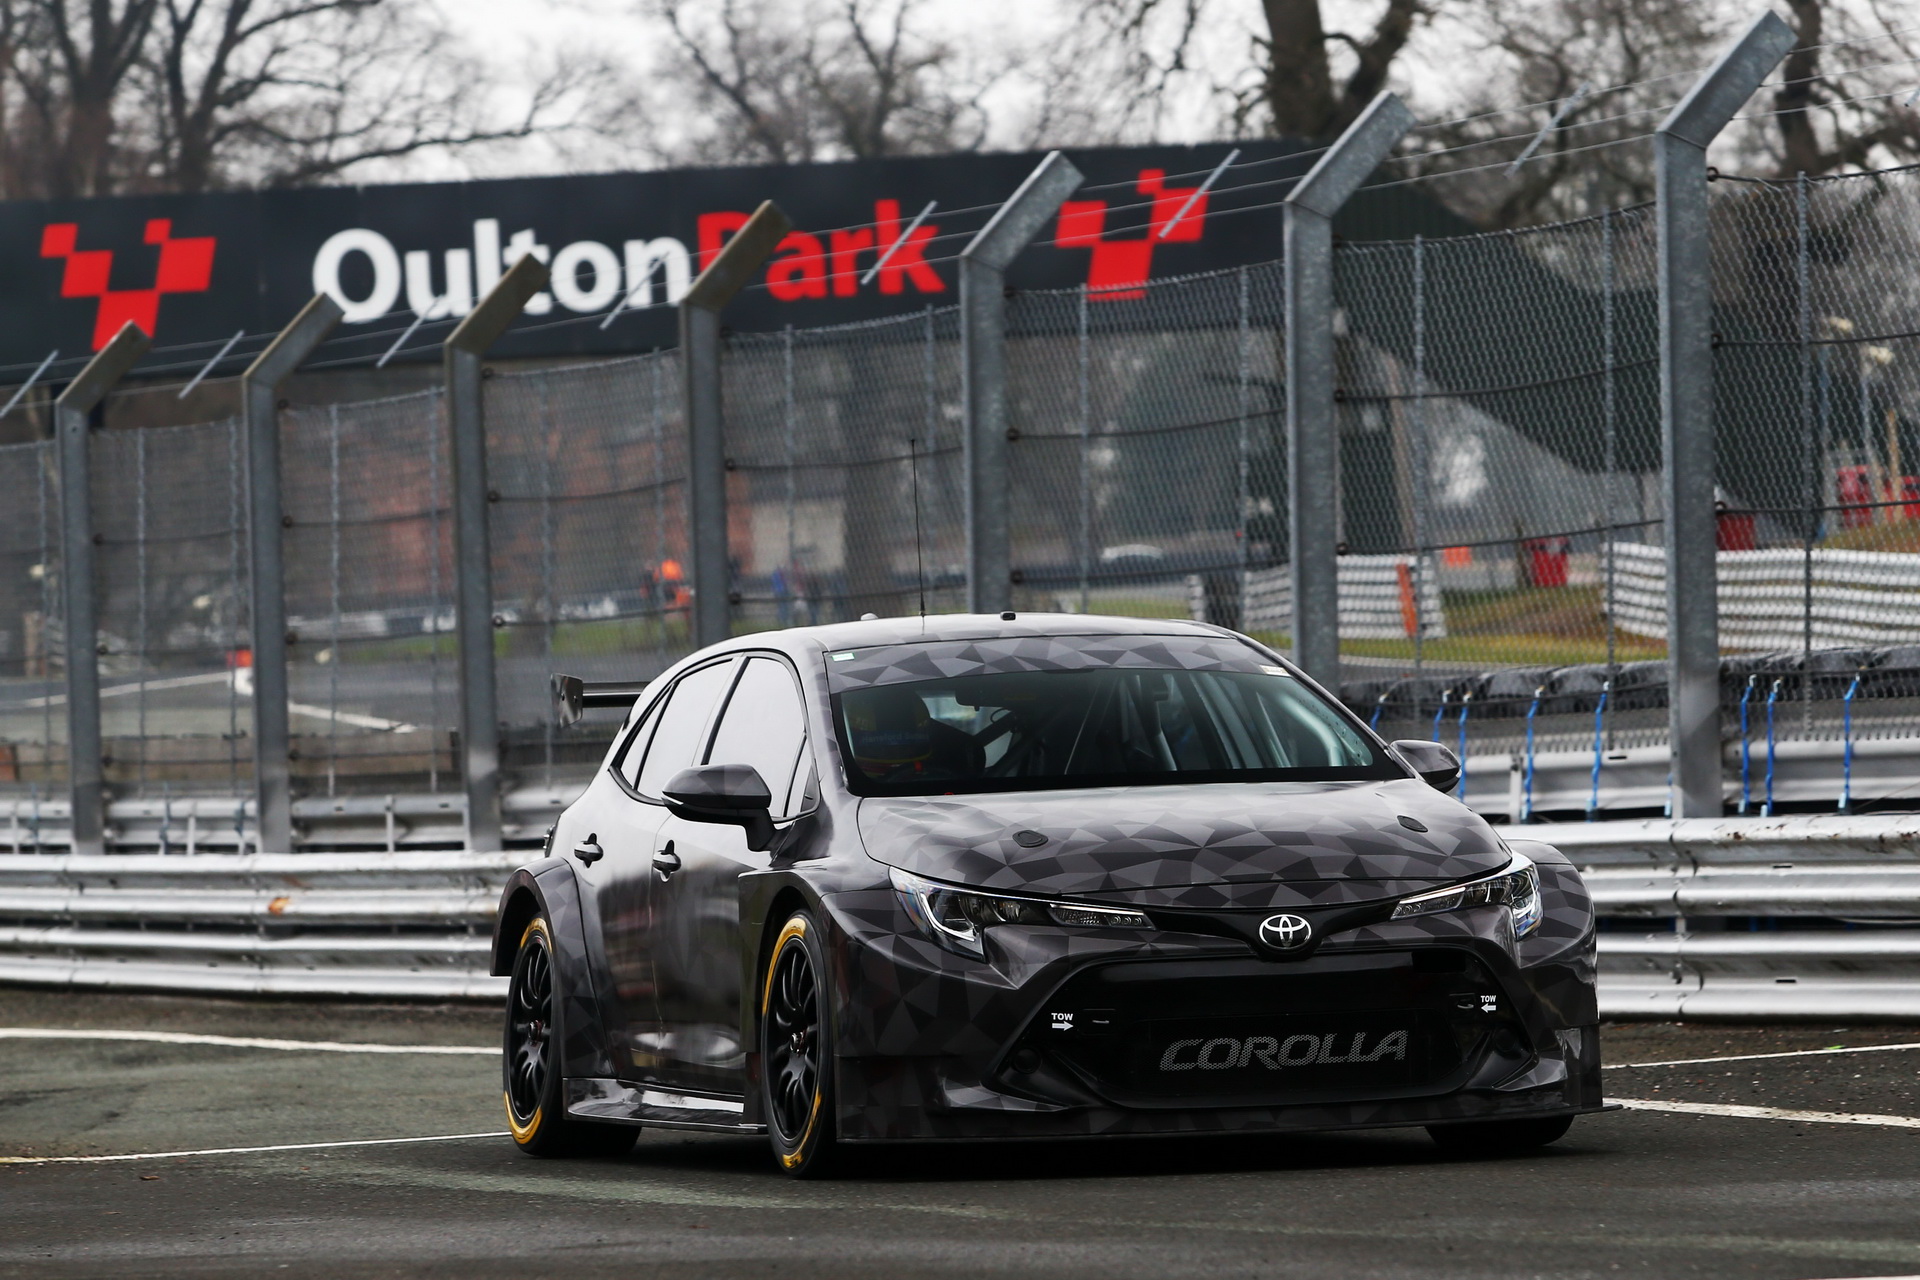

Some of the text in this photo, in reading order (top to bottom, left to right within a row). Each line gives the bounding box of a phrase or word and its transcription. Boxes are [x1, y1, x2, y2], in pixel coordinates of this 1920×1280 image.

[1480, 994, 1497, 1003] TOW
[1050, 1012, 1074, 1021] TOW
[1159, 1030, 1409, 1071] COROLLA
